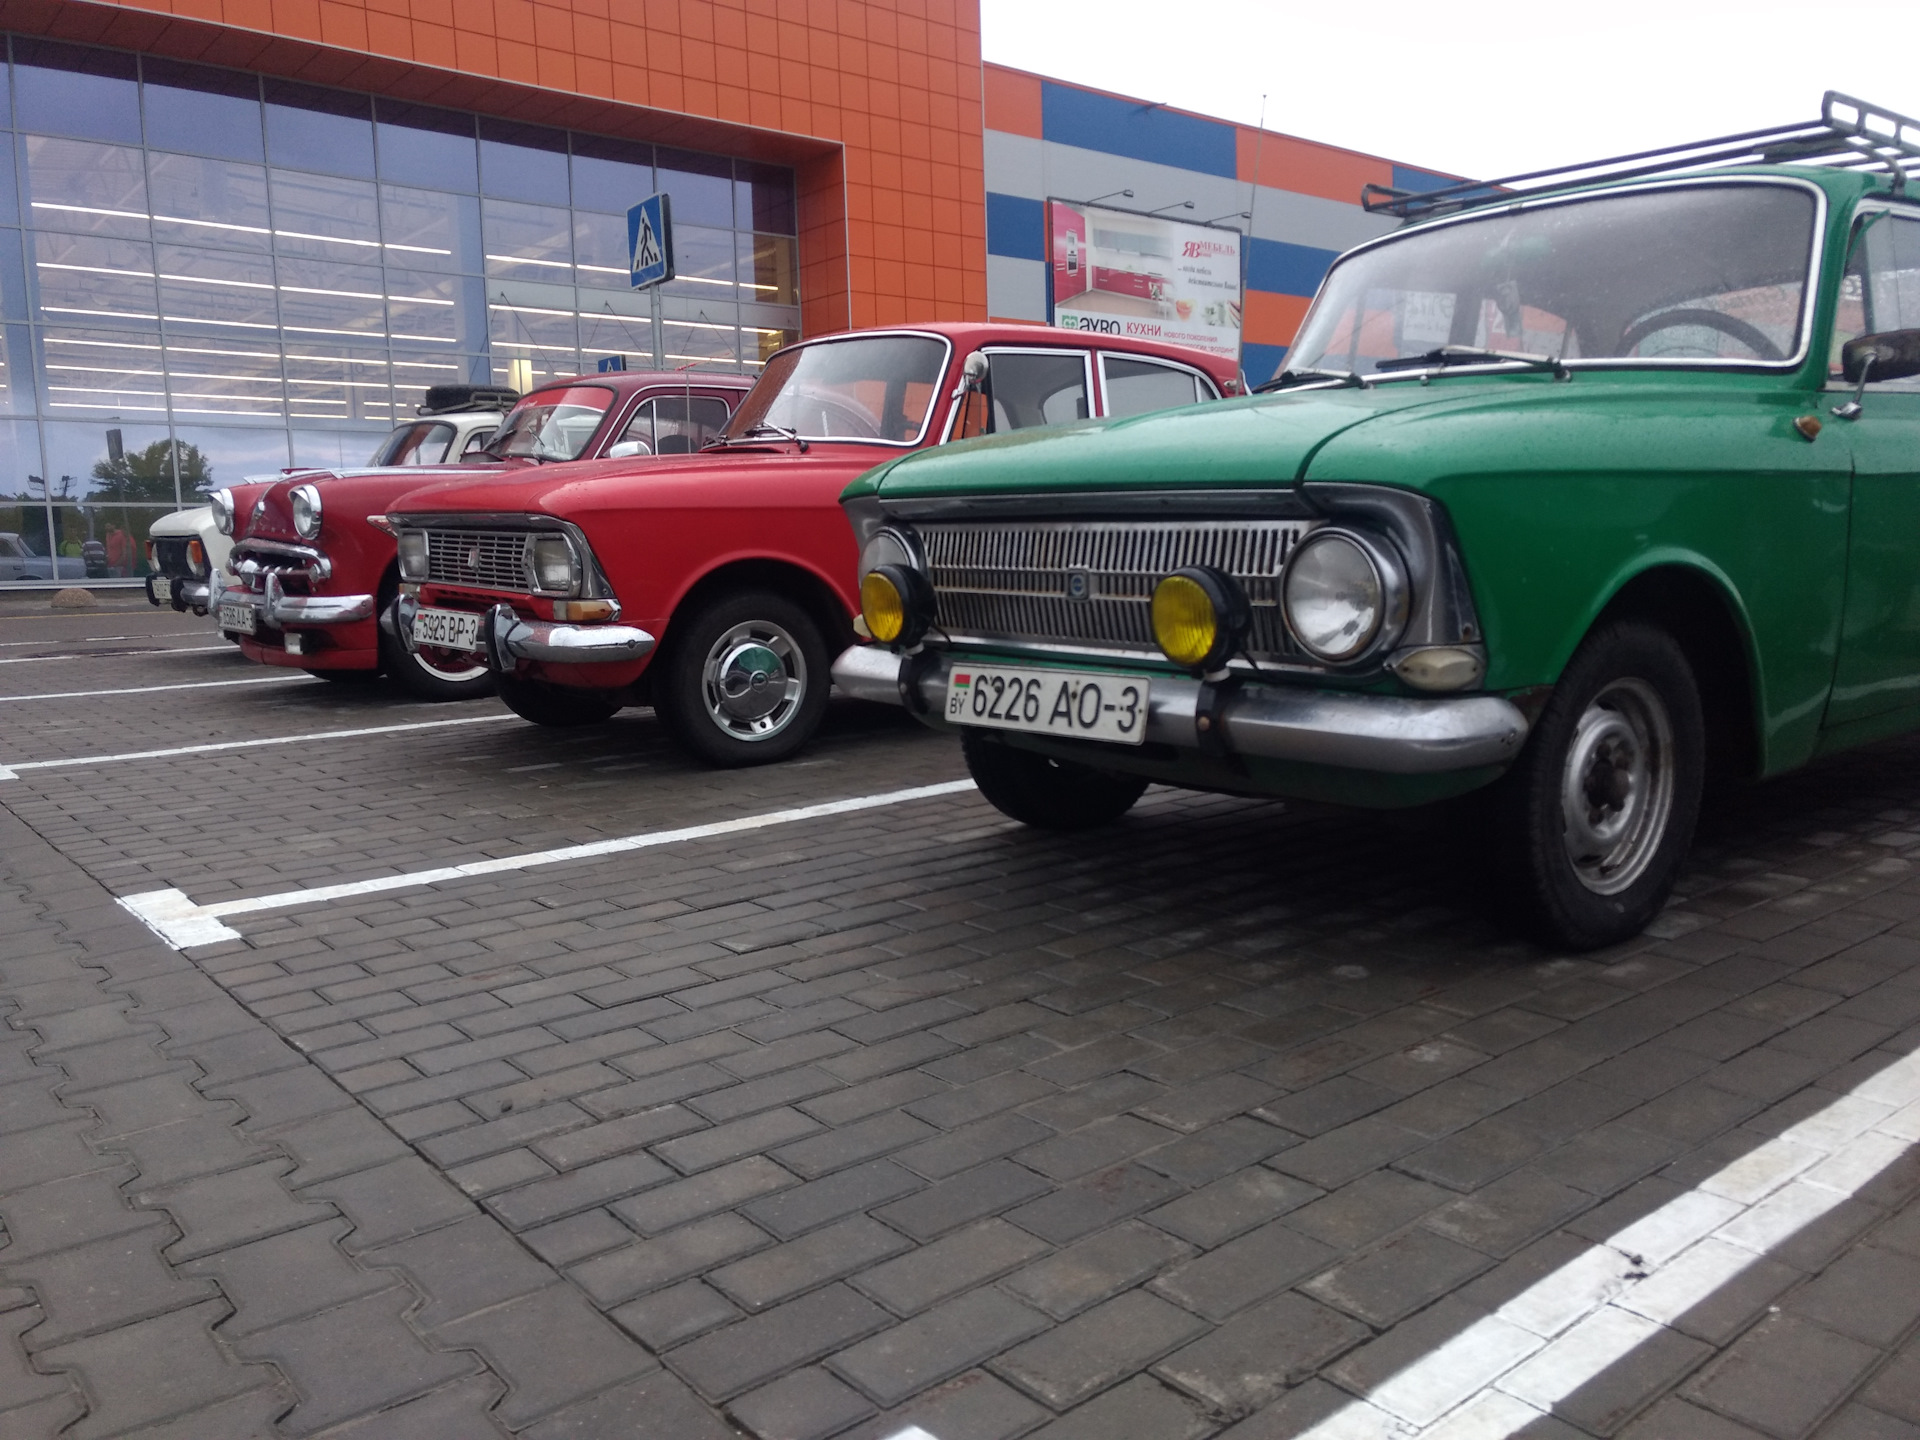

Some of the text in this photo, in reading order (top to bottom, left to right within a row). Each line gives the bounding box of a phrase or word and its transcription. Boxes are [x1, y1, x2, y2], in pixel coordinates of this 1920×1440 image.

[1126, 322, 1162, 337] КУХНИ
[423, 613, 476, 646] 5925 BP-3
[950, 697, 965, 715] BY
[973, 674, 1140, 734] 6226 AO-3
